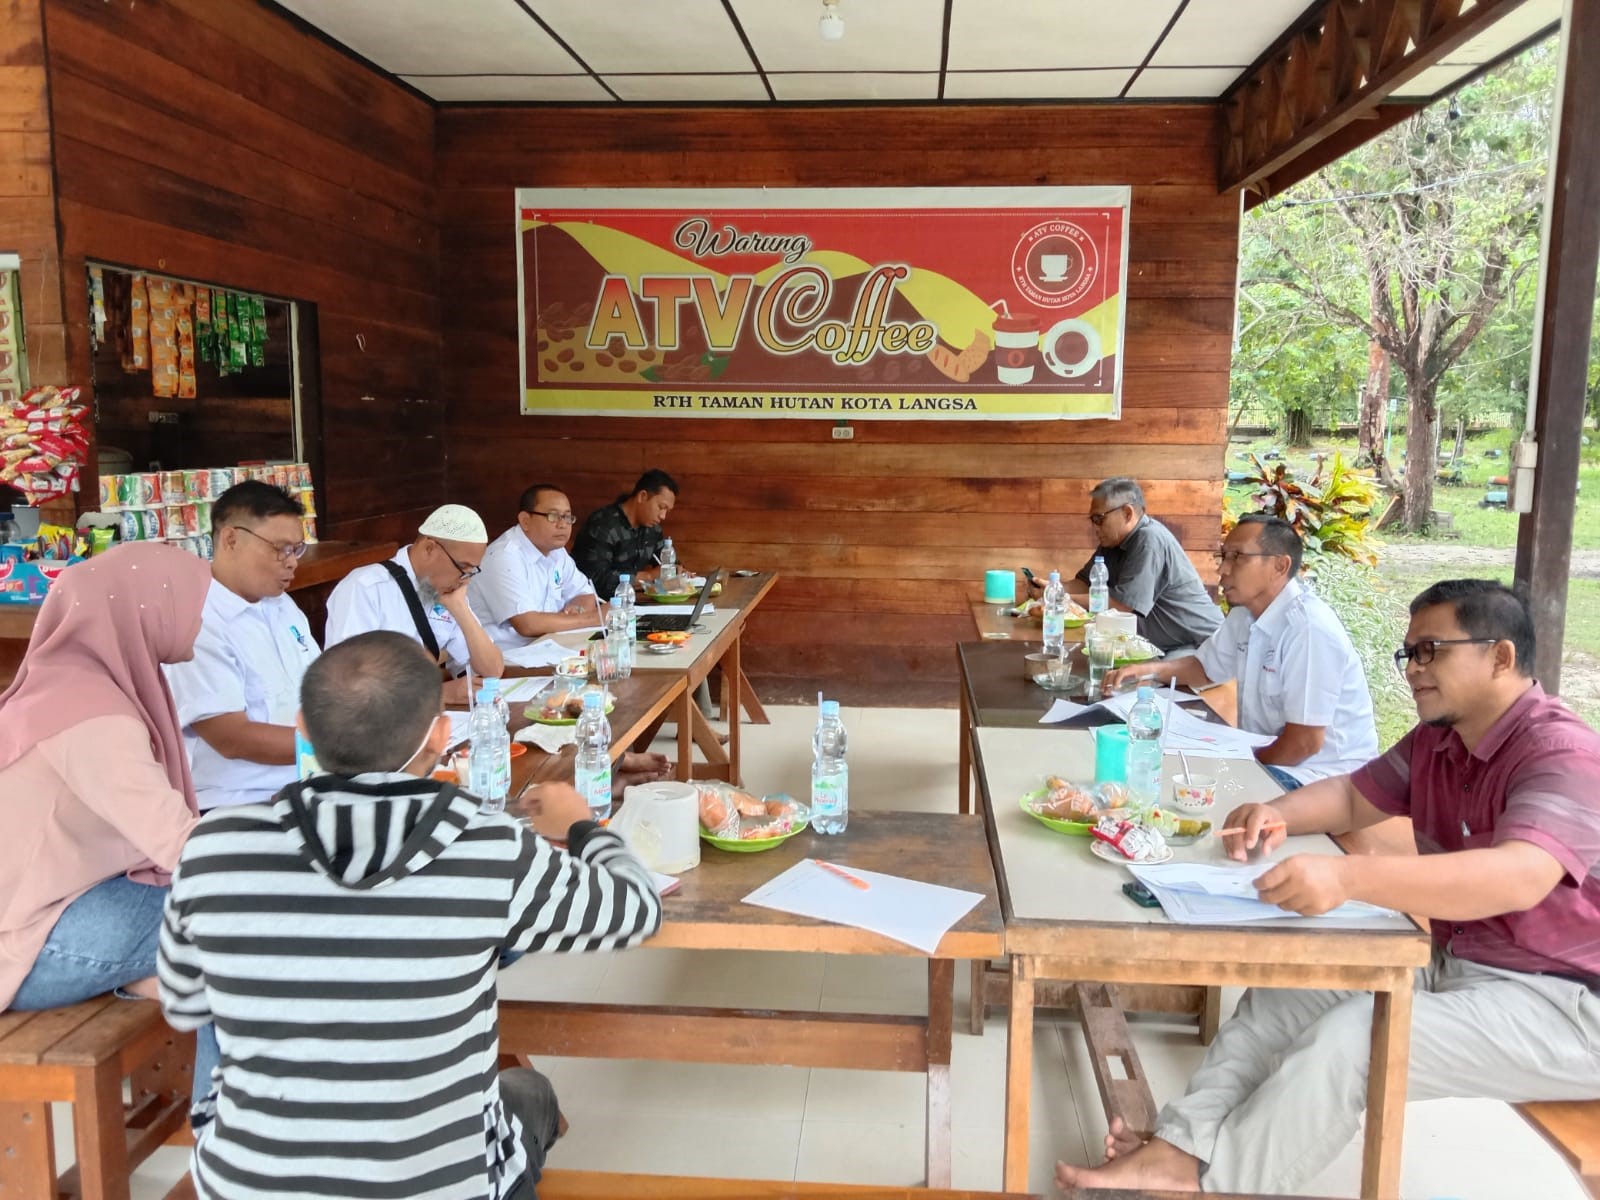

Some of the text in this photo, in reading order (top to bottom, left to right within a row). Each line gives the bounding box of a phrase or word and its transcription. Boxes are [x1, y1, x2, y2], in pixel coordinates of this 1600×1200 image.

[676, 219, 810, 263] Warung
[1049, 224, 1080, 238] COFFEE
[588, 266, 935, 362] ATV Coffee
[653, 395, 978, 411] RTH TAMAN HUTAN KOTA LANGSA
